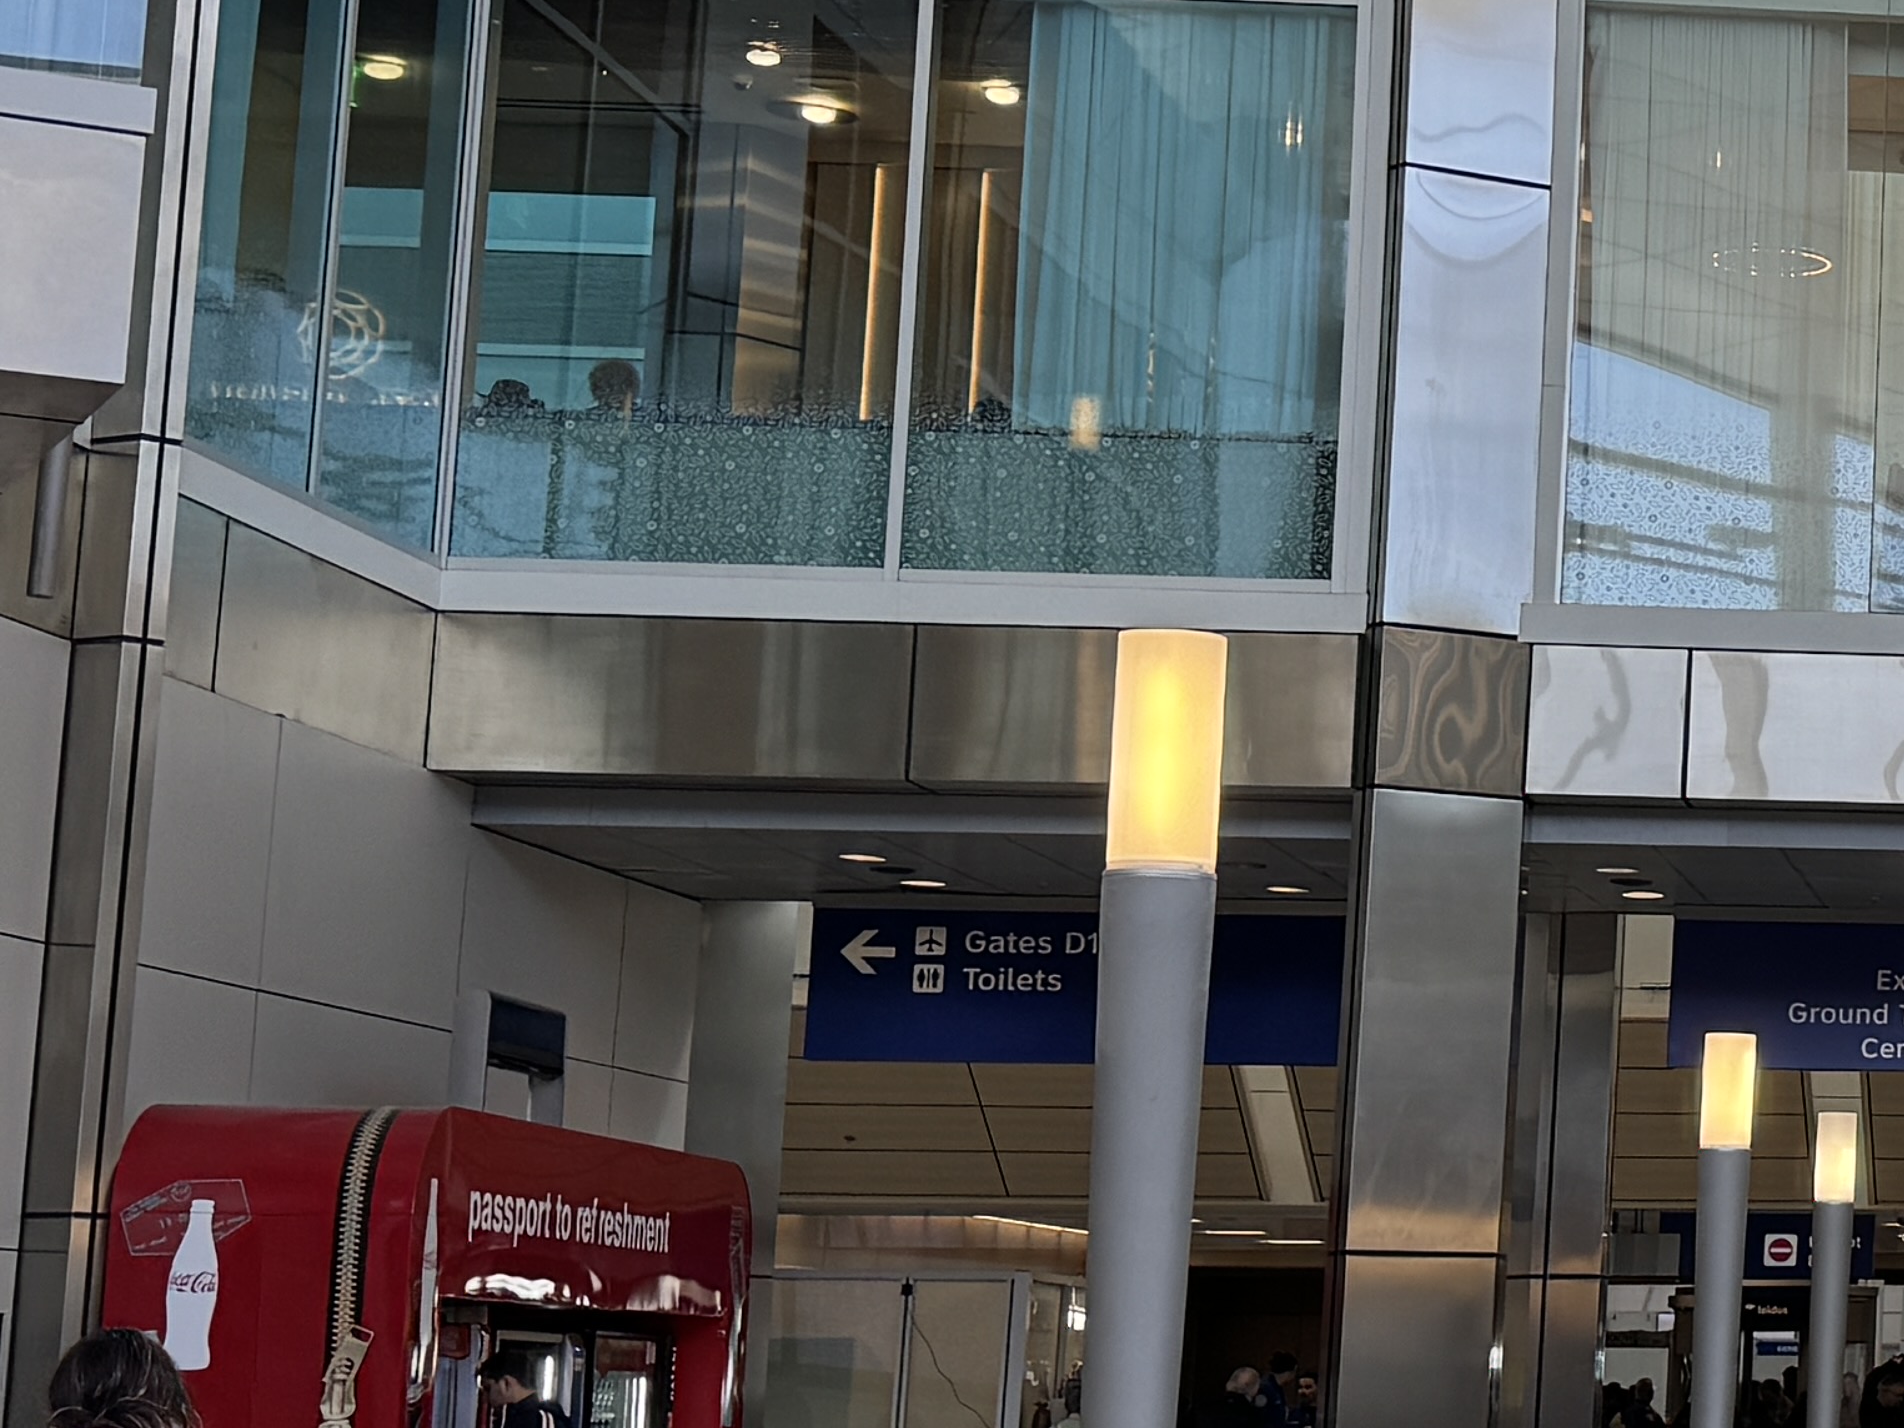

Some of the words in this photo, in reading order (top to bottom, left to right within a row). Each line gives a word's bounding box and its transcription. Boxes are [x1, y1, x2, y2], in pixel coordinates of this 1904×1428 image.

[964, 931, 1052, 955] Gates
[963, 967, 1062, 992] Toilets
[1788, 1002, 1889, 1025] Ground
[467, 1189, 552, 1248] passport
[555, 1194, 572, 1241] to
[575, 1196, 671, 1254] refreshment
